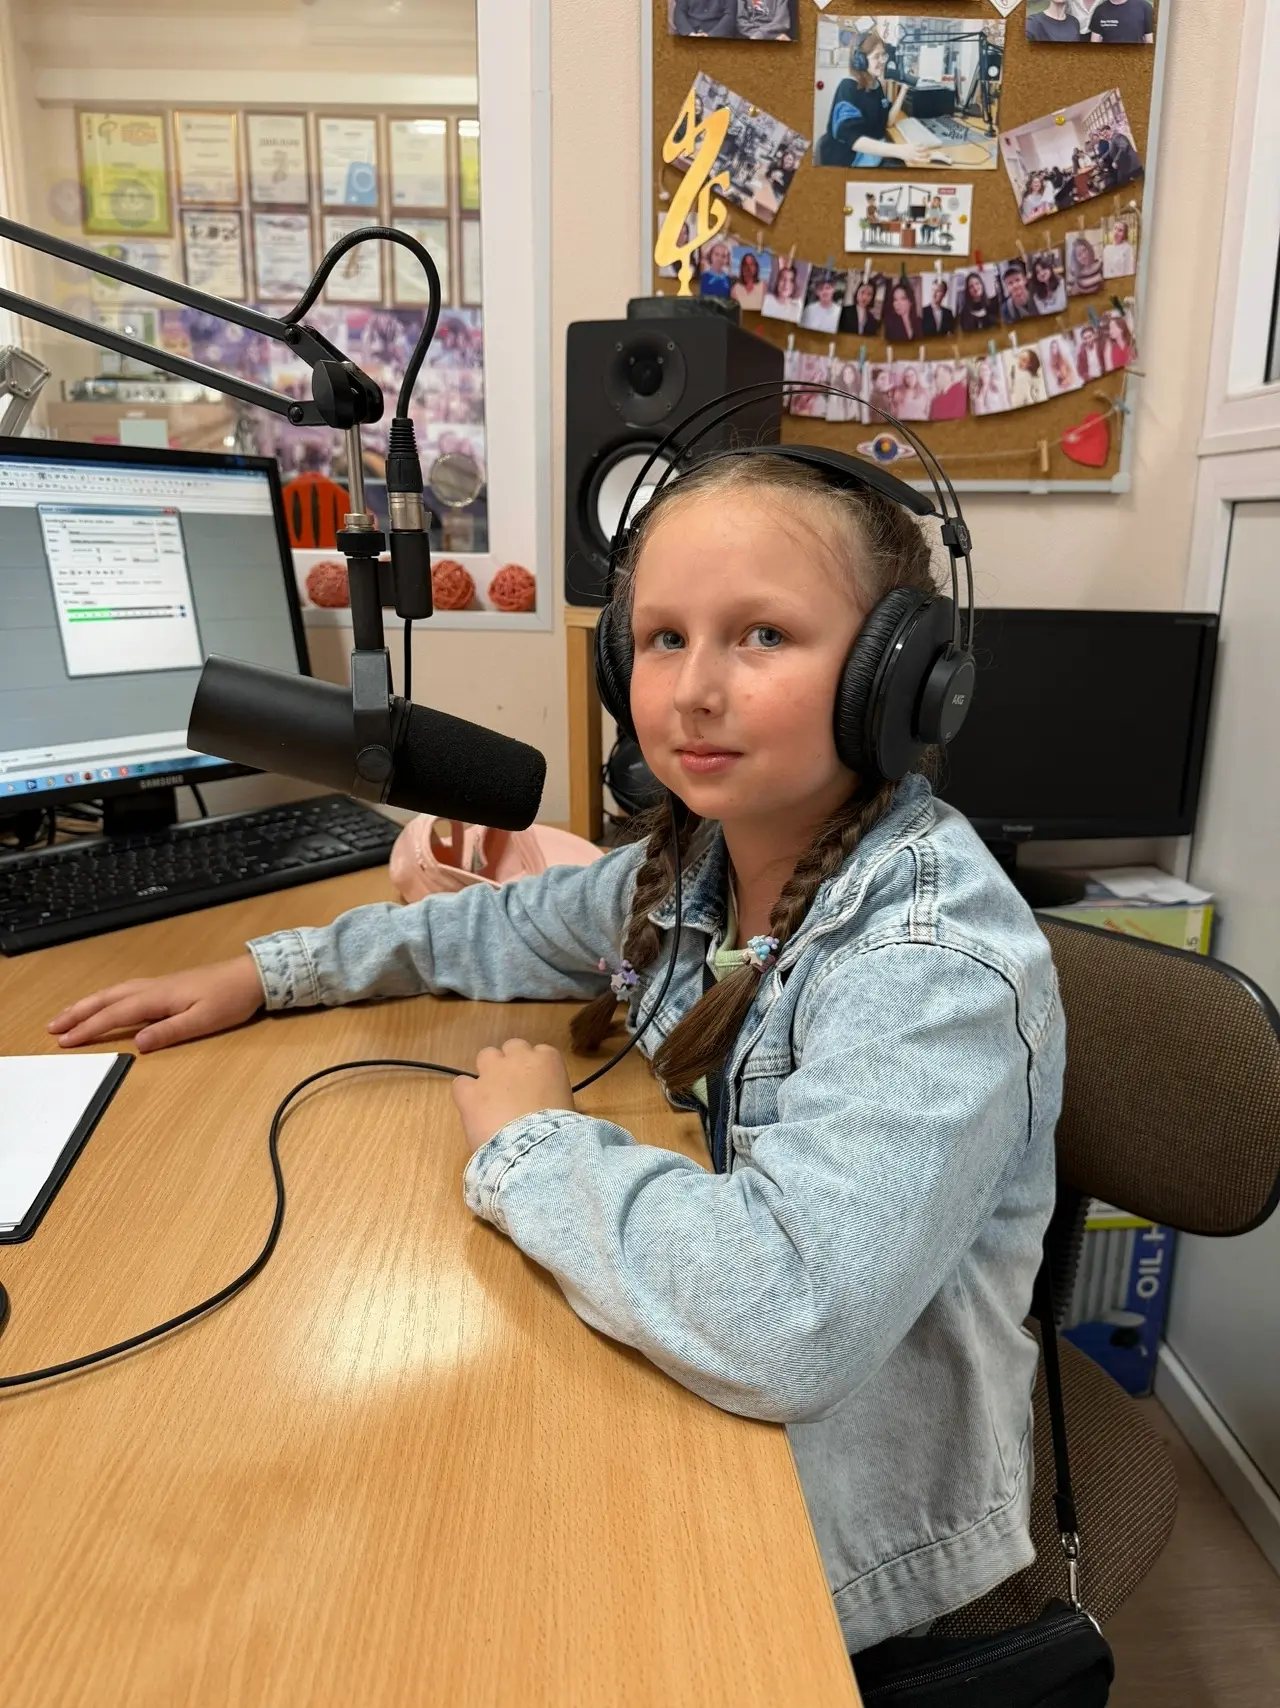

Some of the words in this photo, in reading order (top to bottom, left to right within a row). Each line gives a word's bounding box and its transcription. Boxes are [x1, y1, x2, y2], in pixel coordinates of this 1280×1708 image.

[952, 694, 965, 705] AKG
[140, 774, 184, 790] SAMSUNG
[1136, 1249, 1163, 1298] OIL
